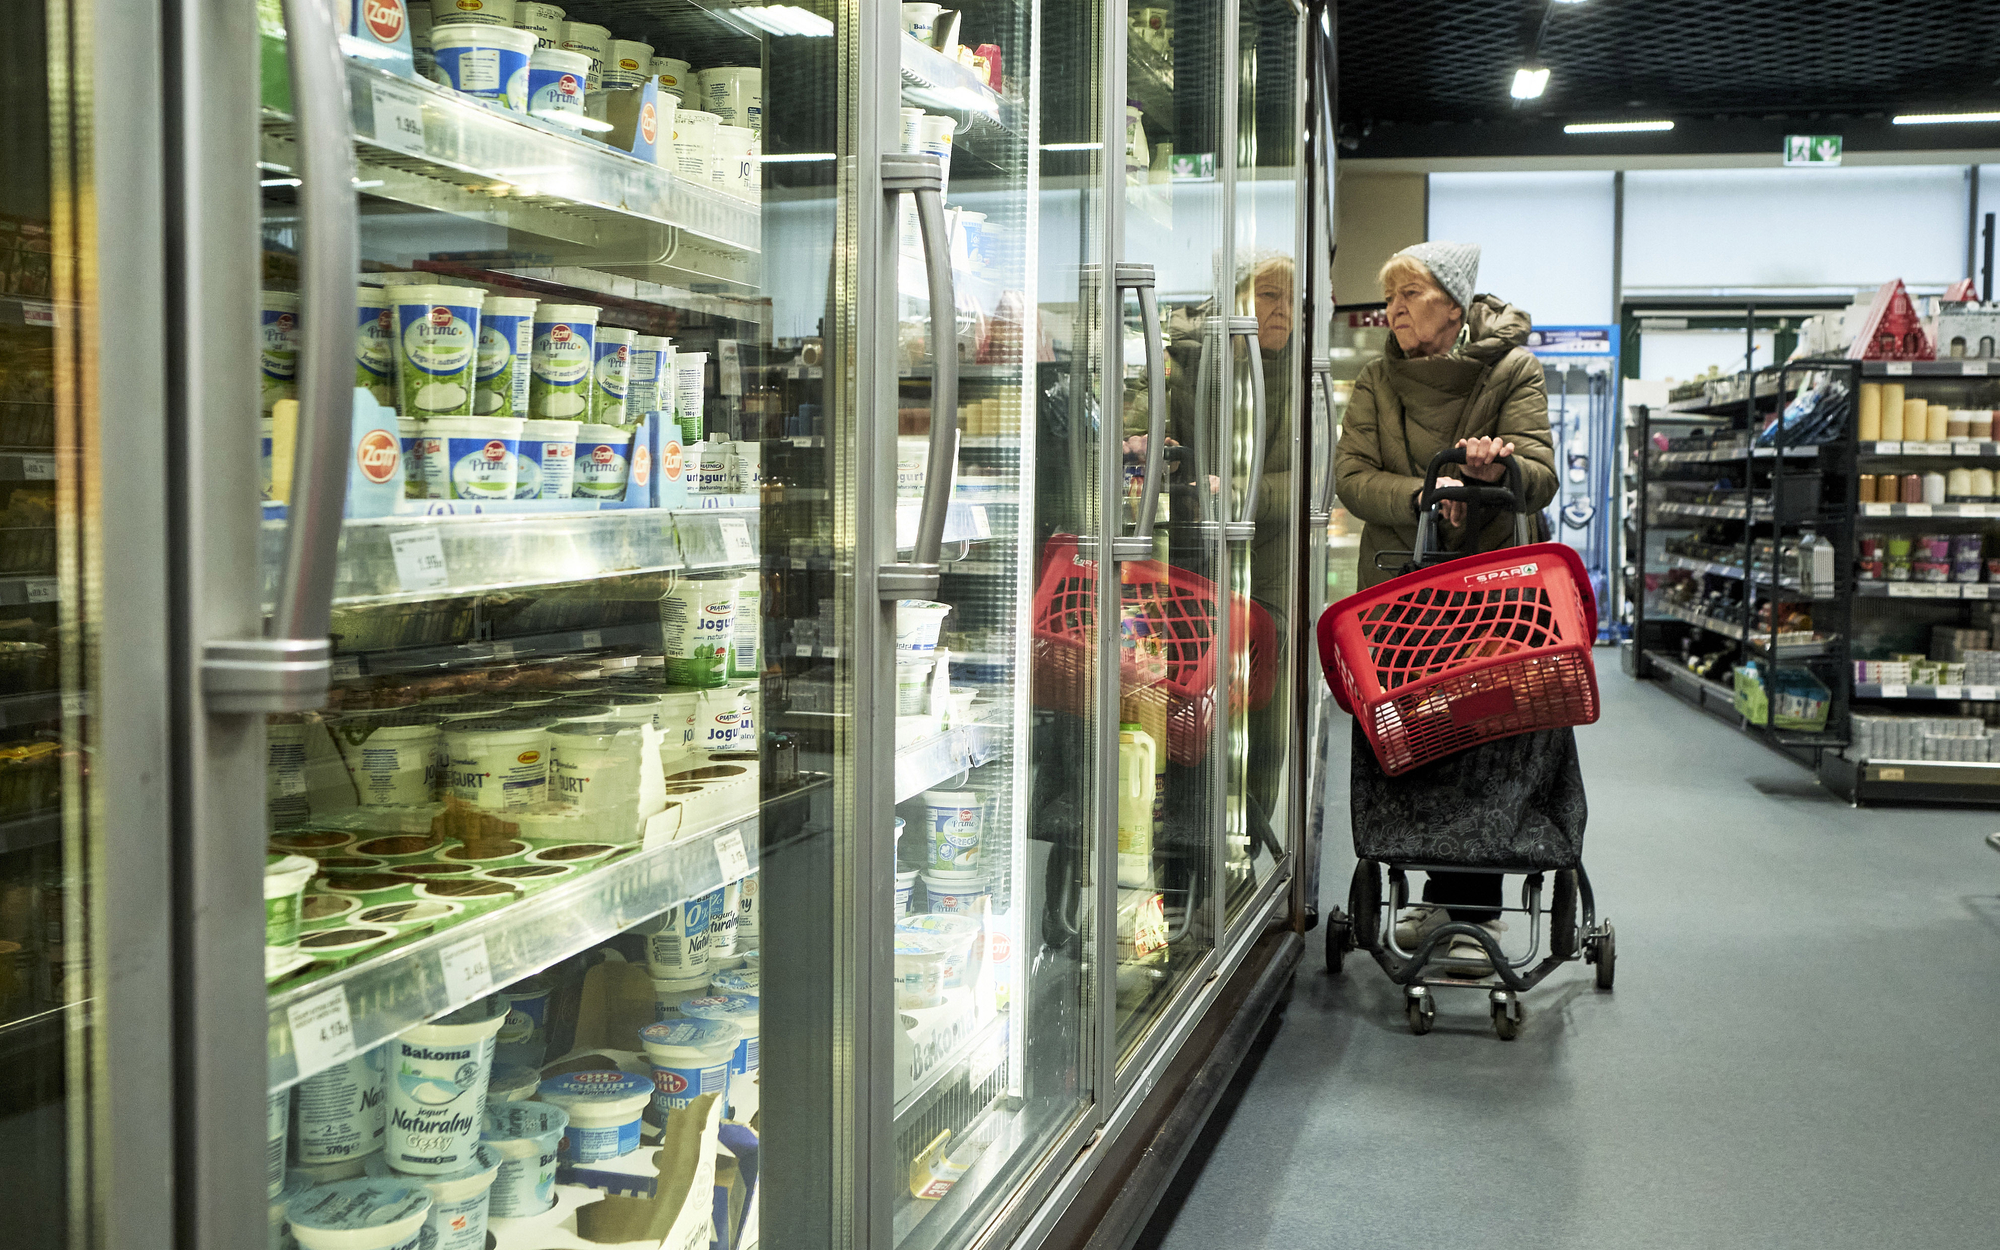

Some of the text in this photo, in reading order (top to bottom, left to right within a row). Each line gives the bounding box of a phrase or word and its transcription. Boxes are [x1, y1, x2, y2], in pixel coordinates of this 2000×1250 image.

[369, 1, 403, 28] Zott
[416, 323, 458, 336] Primo
[554, 330, 572, 339] Zott
[540, 338, 577, 351] Primo
[364, 445, 397, 467] Zott
[486, 448, 505, 457] Zott
[594, 450, 612, 460] Zott
[470, 459, 508, 472] Primo
[580, 460, 617, 473] Primo
[665, 454, 682, 469] Zott
[700, 473, 726, 484] ogurt
[1476, 568, 1521, 582] SPAR
[992, 940, 1007, 955] ott
[402, 1044, 470, 1060] Bakoma
[417, 1108, 448, 1118] jogurt
[391, 1108, 474, 1136] Naturalny
